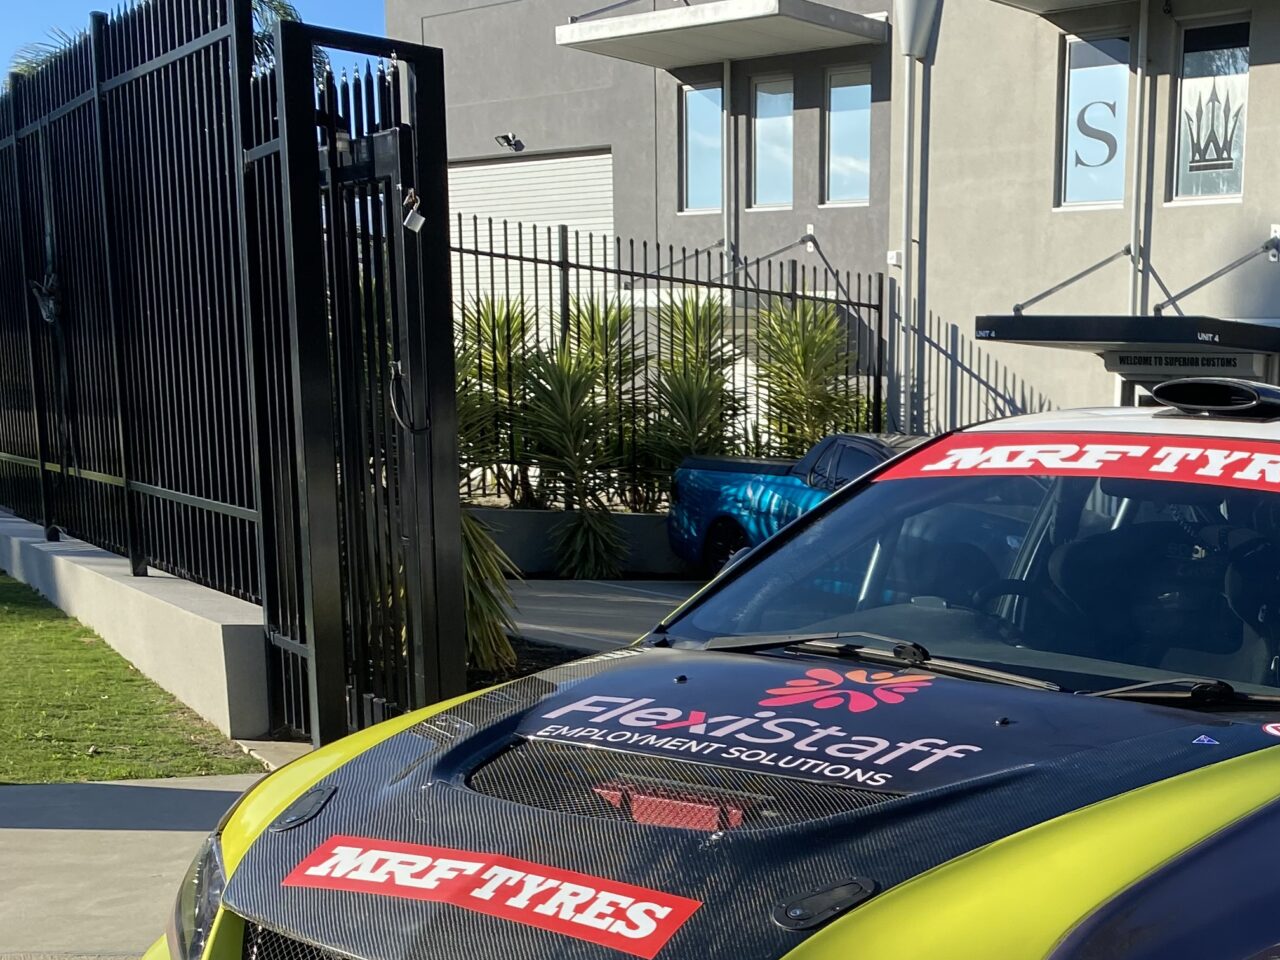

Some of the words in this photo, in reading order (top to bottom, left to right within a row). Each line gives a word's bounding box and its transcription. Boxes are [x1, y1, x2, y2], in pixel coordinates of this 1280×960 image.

[1074, 101, 1118, 167] S
[1119, 355, 1152, 366] WELCOME
[1154, 356, 1164, 367] TO
[1164, 356, 1199, 367] SUPERIOR
[1200, 357, 1238, 368] CUSTOMS
[1197, 332, 1213, 342] UNIT
[1214, 334, 1220, 342] 4
[921, 444, 1145, 471] MRF
[536, 724, 728, 755] EMPLOYMENT
[721, 746, 894, 787] SOLUTIONS
[541, 695, 983, 772] FlexiStaff
[304, 845, 481, 889] MRF
[470, 865, 673, 939] TYRES
